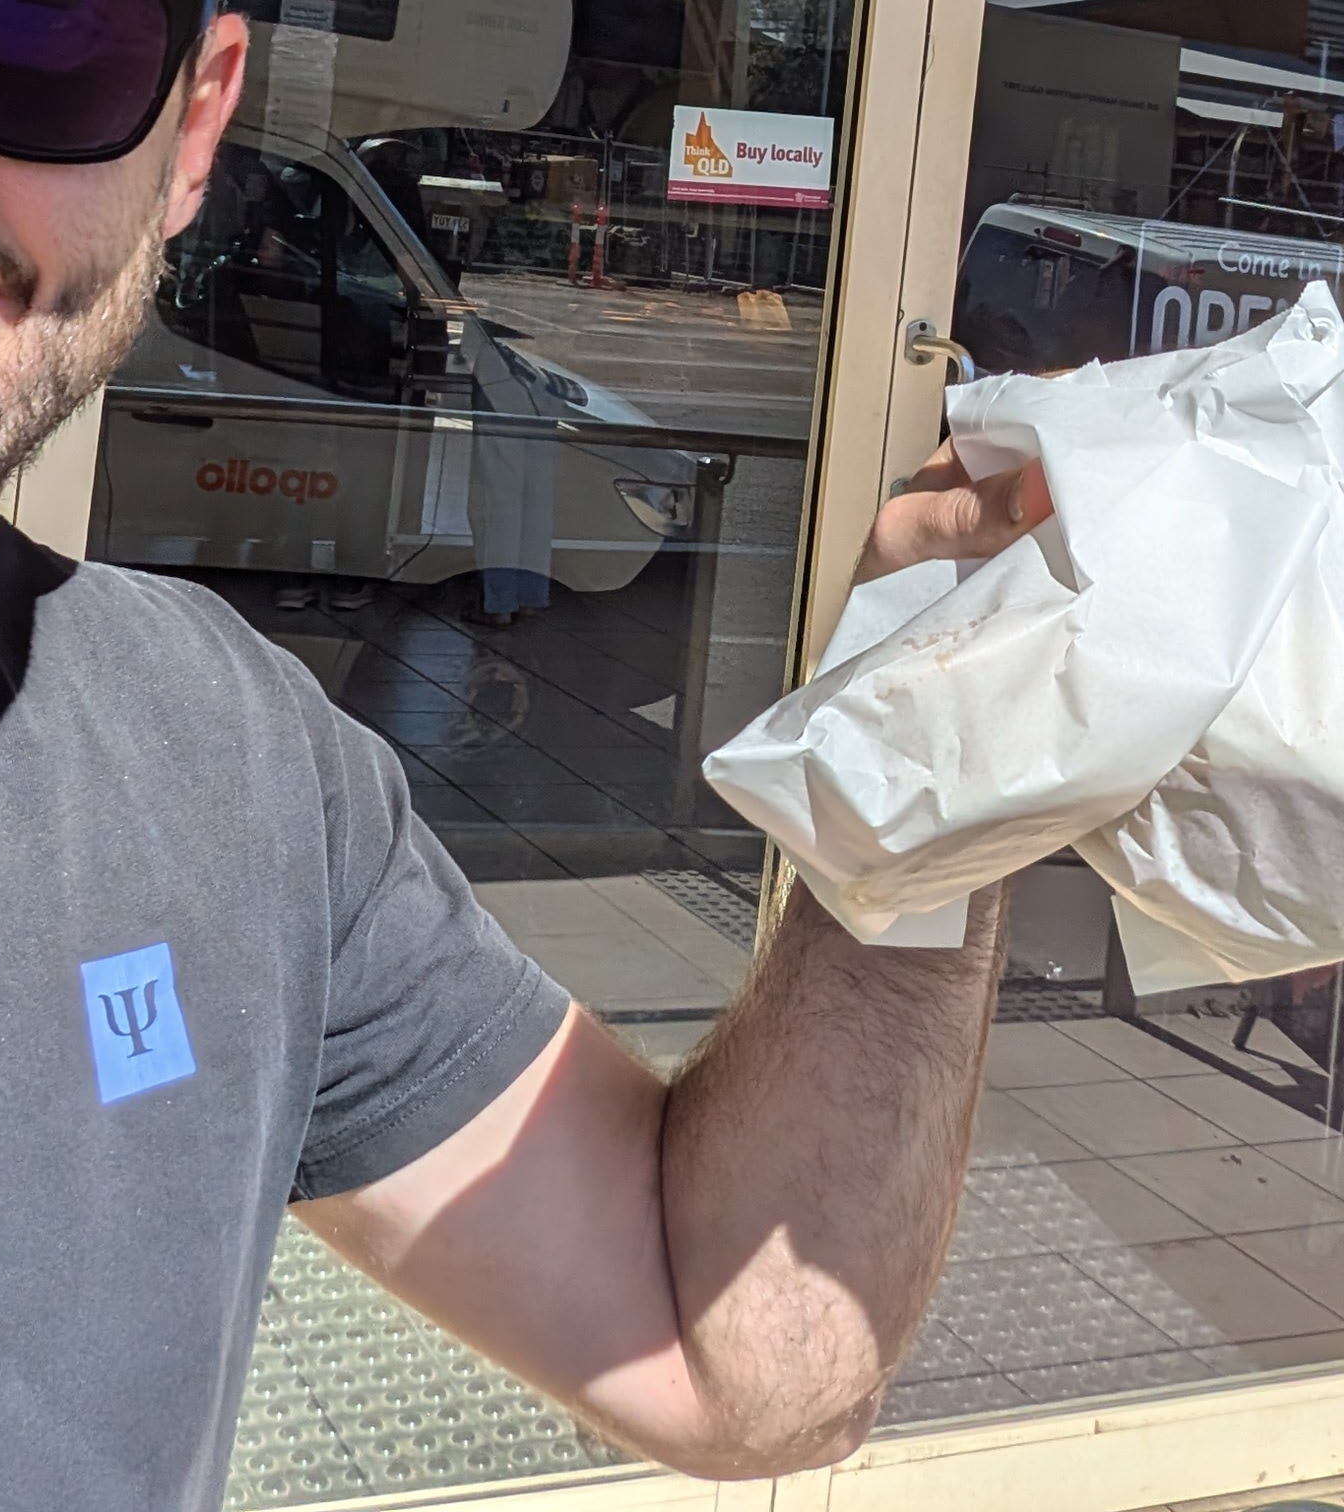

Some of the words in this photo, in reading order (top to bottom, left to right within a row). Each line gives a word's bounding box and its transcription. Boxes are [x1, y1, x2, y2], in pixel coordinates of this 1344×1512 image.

[685, 145, 711, 157] Think
[736, 142, 768, 165] Buy
[771, 144, 823, 168] locally
[697, 159, 729, 176] QLD
[1216, 241, 1290, 279] Come
[1298, 249, 1323, 281] in
